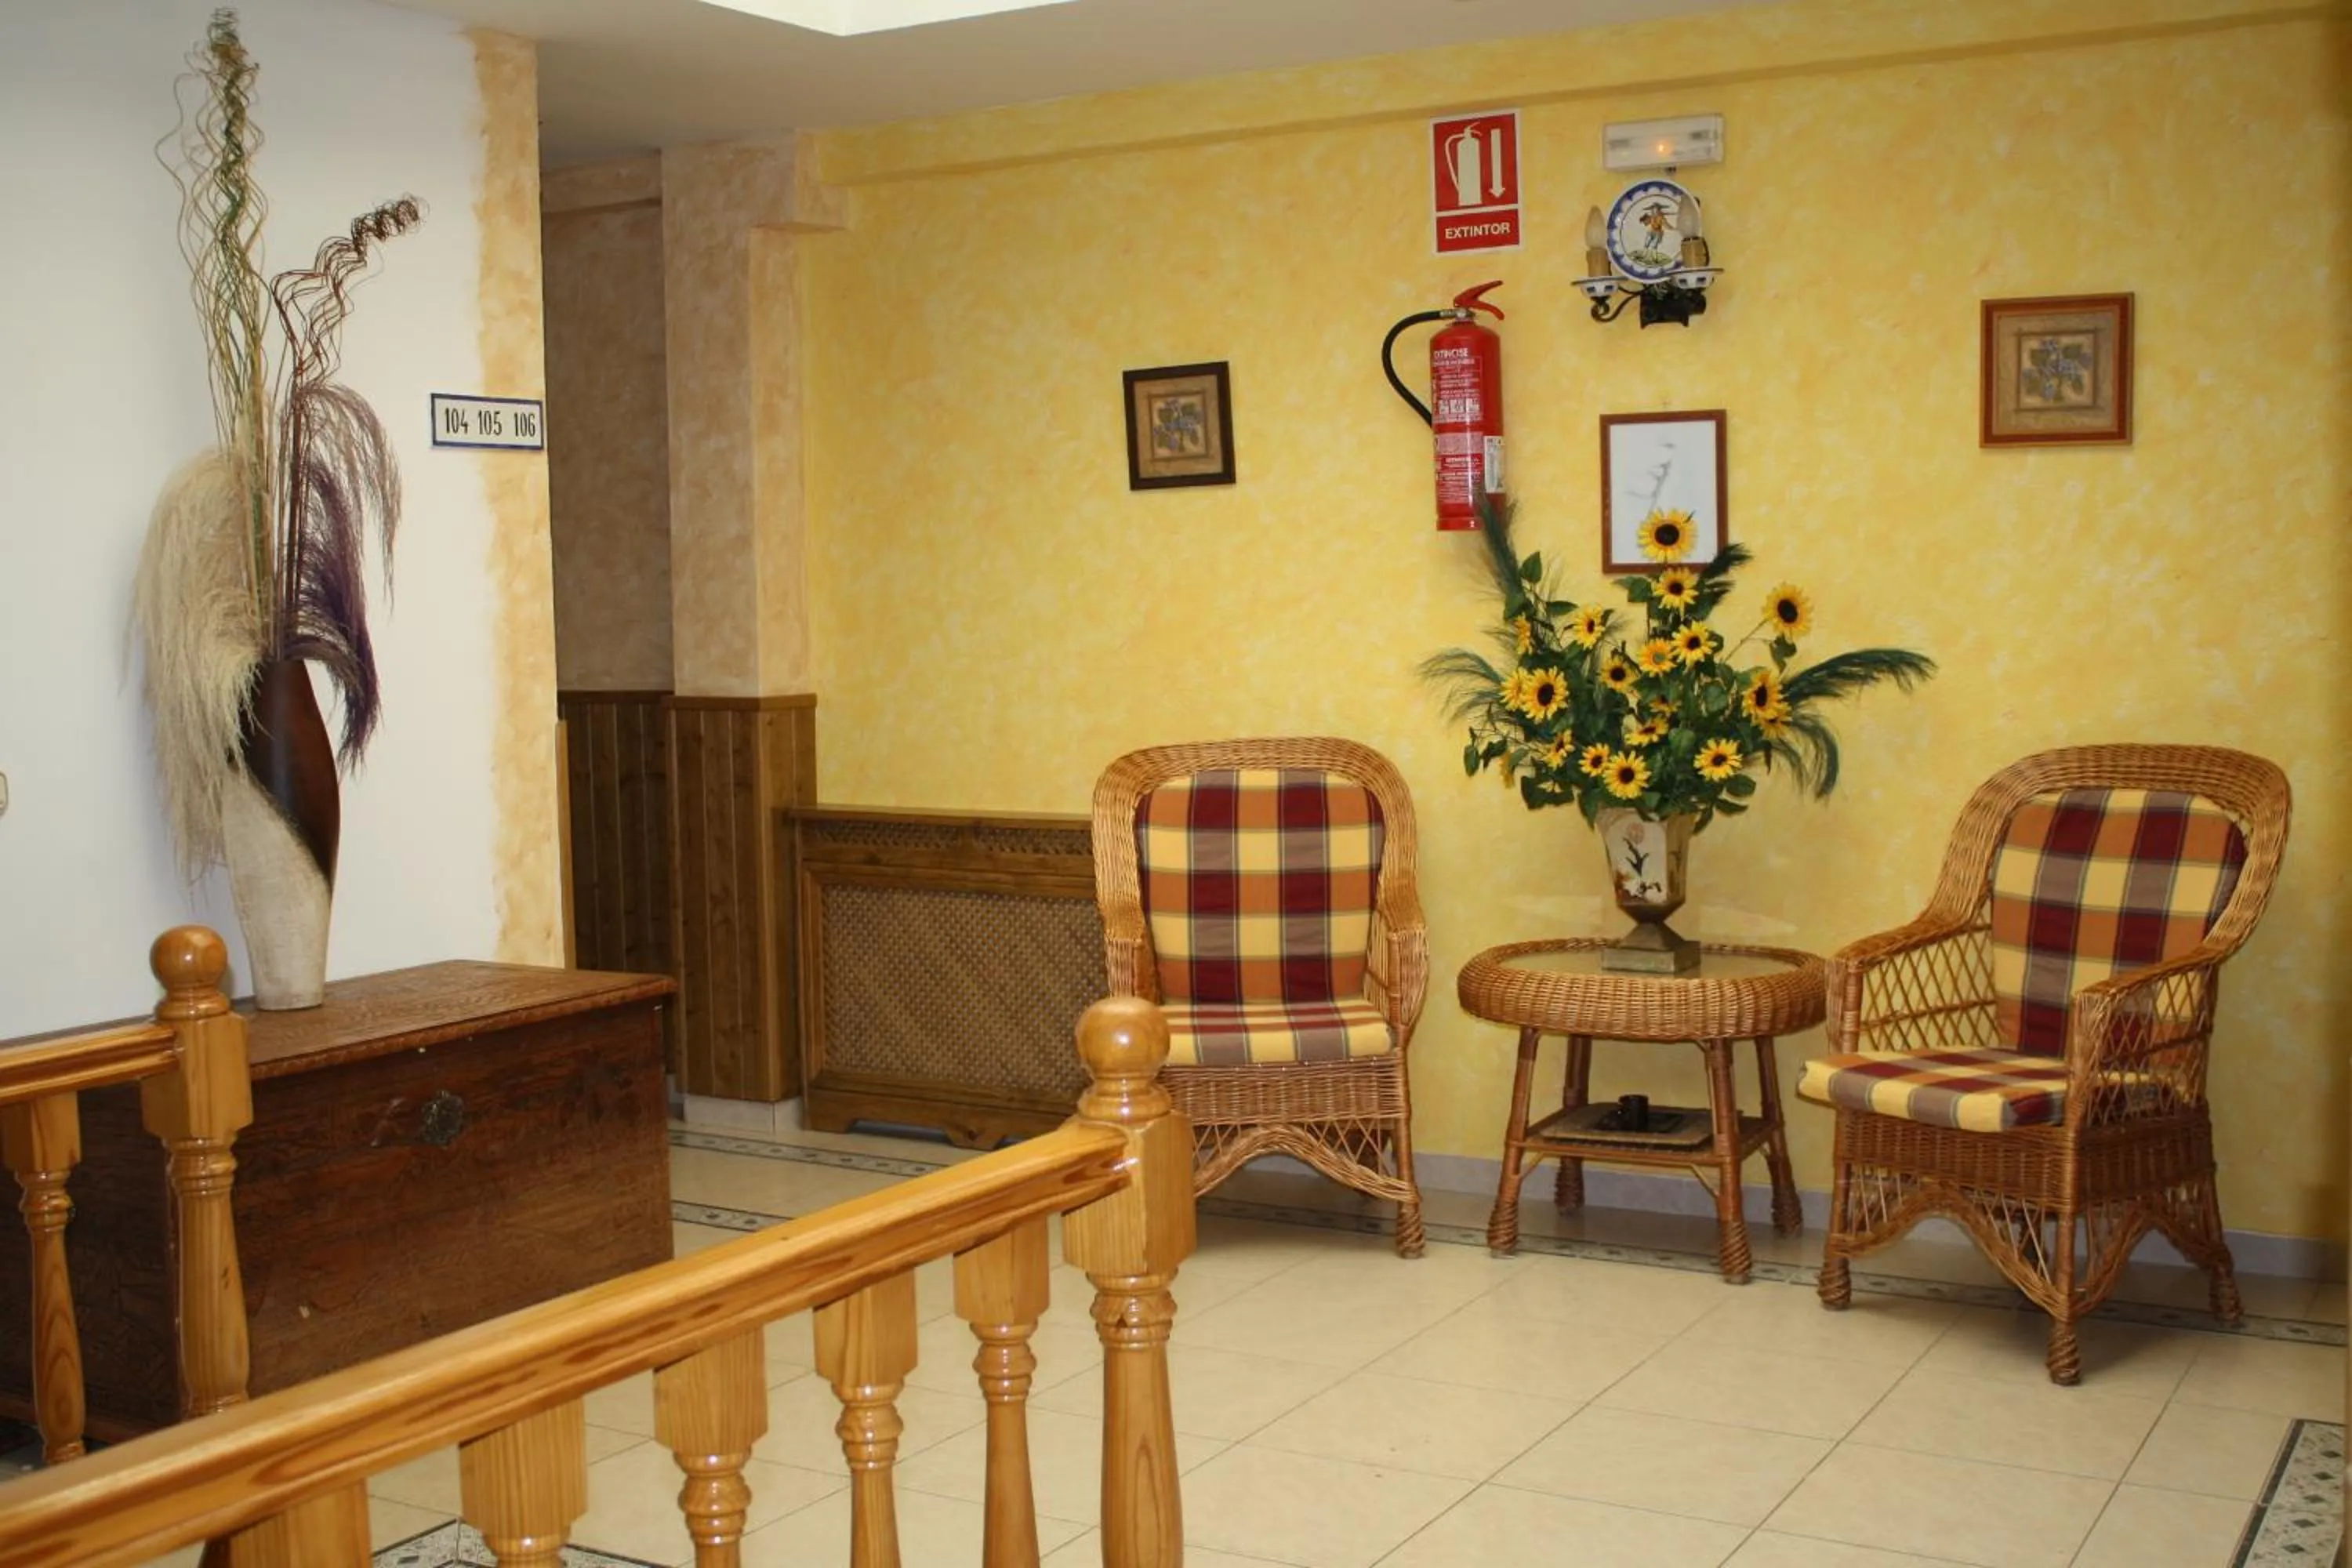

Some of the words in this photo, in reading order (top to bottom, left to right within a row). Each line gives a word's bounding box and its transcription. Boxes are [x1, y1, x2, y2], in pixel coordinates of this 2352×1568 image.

[1445, 222, 1511, 239] EXTINTOR
[445, 407, 468, 434] 104
[477, 410, 503, 435] 105
[514, 412, 535, 437] 106
